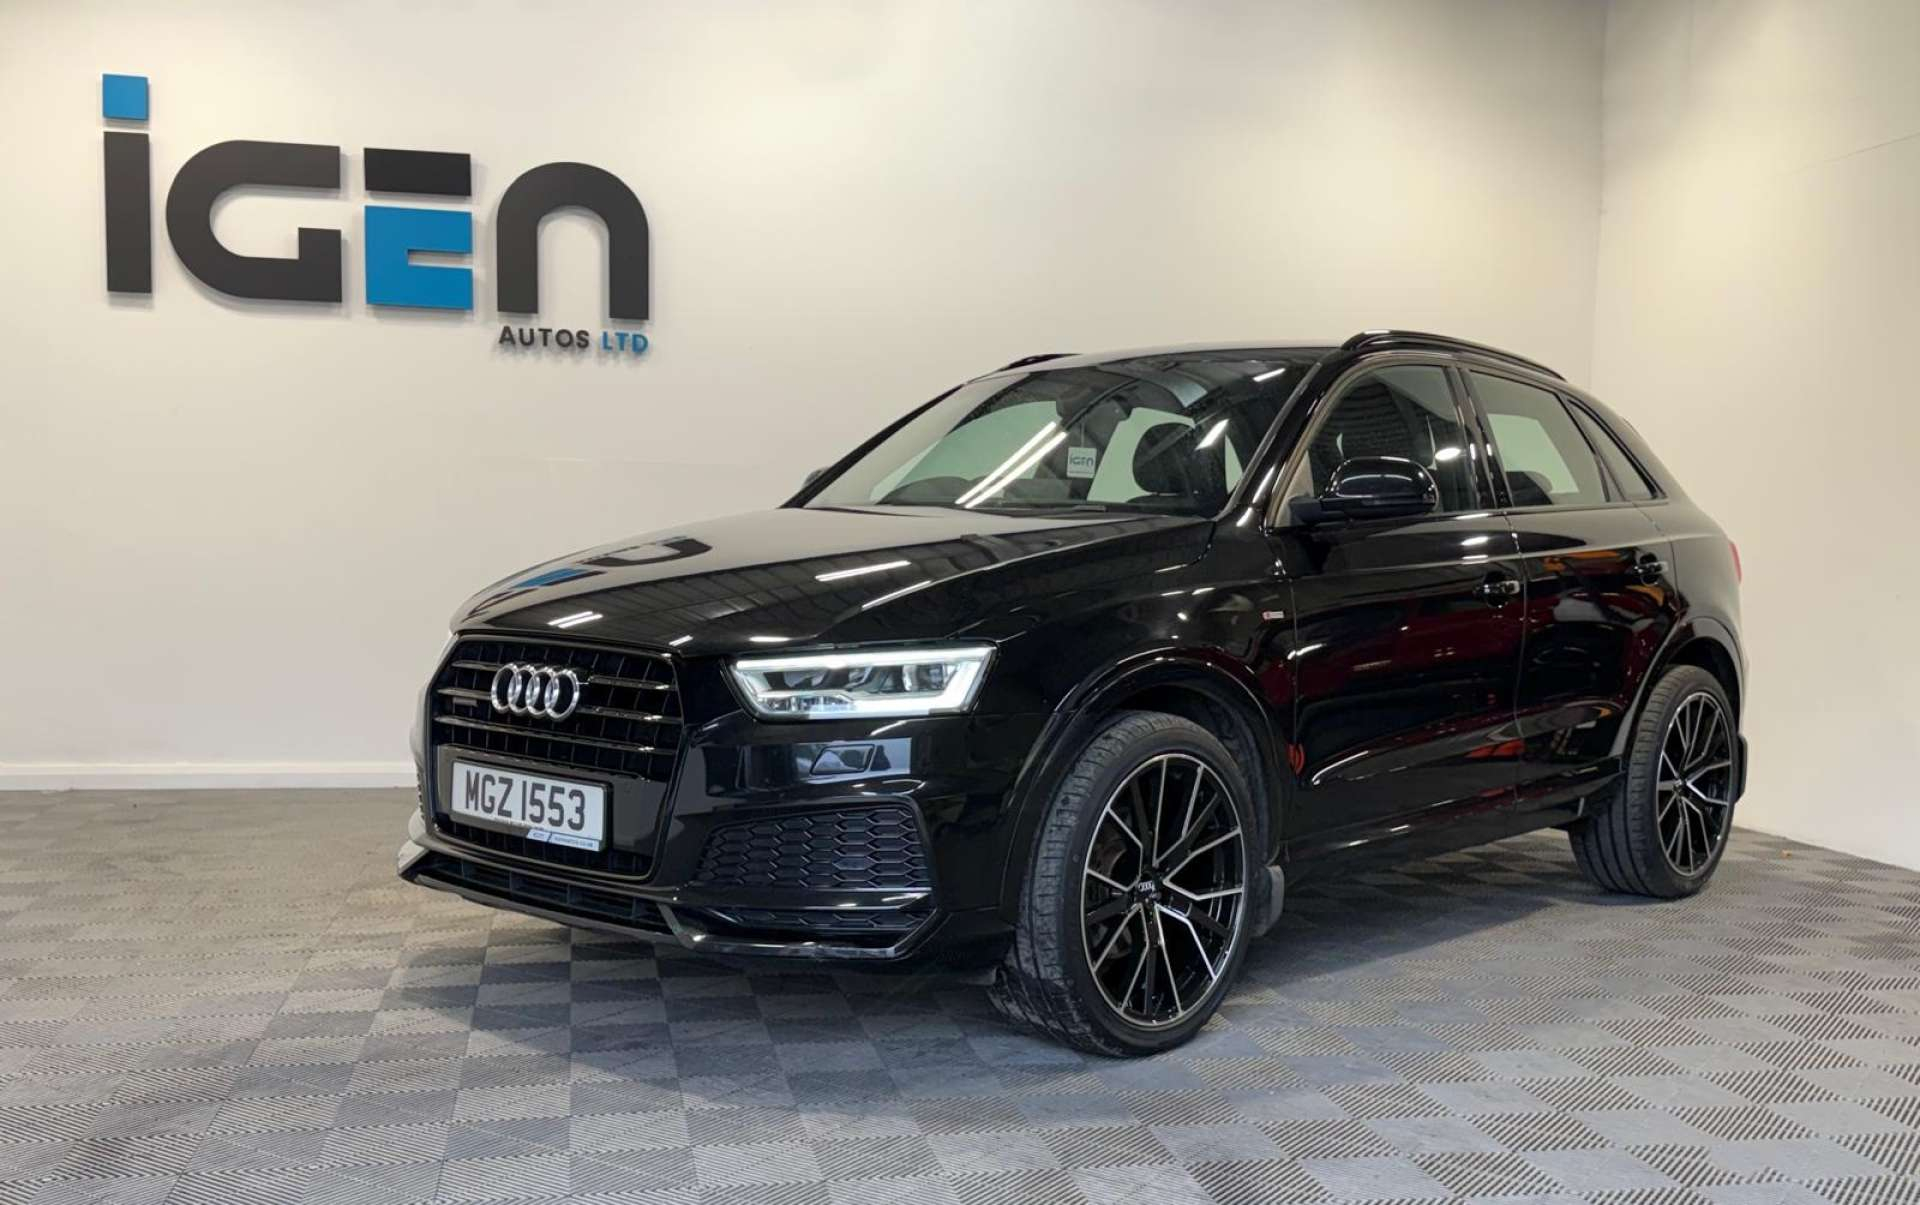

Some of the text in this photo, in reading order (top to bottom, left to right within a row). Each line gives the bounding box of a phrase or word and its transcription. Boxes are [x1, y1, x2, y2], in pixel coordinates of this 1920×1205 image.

[499, 326, 649, 353] AUTOS LTD
[465, 770, 585, 831] MGZ 1553
